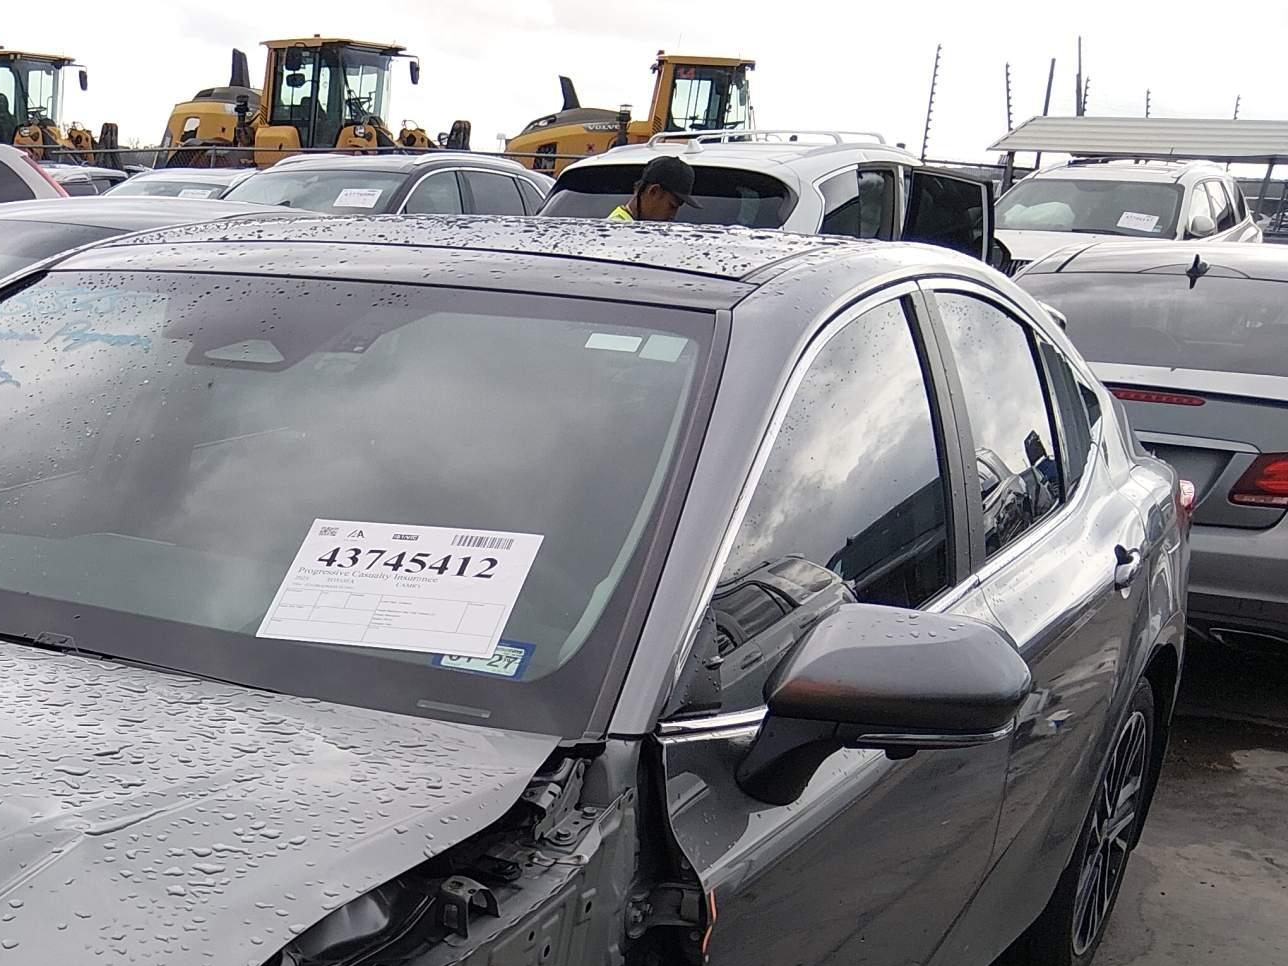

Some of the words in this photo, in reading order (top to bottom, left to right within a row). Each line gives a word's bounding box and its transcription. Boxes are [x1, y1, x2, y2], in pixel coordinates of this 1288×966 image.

[298, 566, 350, 577] Progressive
[351, 570, 392, 581] Casualty
[393, 573, 439, 583] Insurance
[317, 546, 499, 579] 43745412
